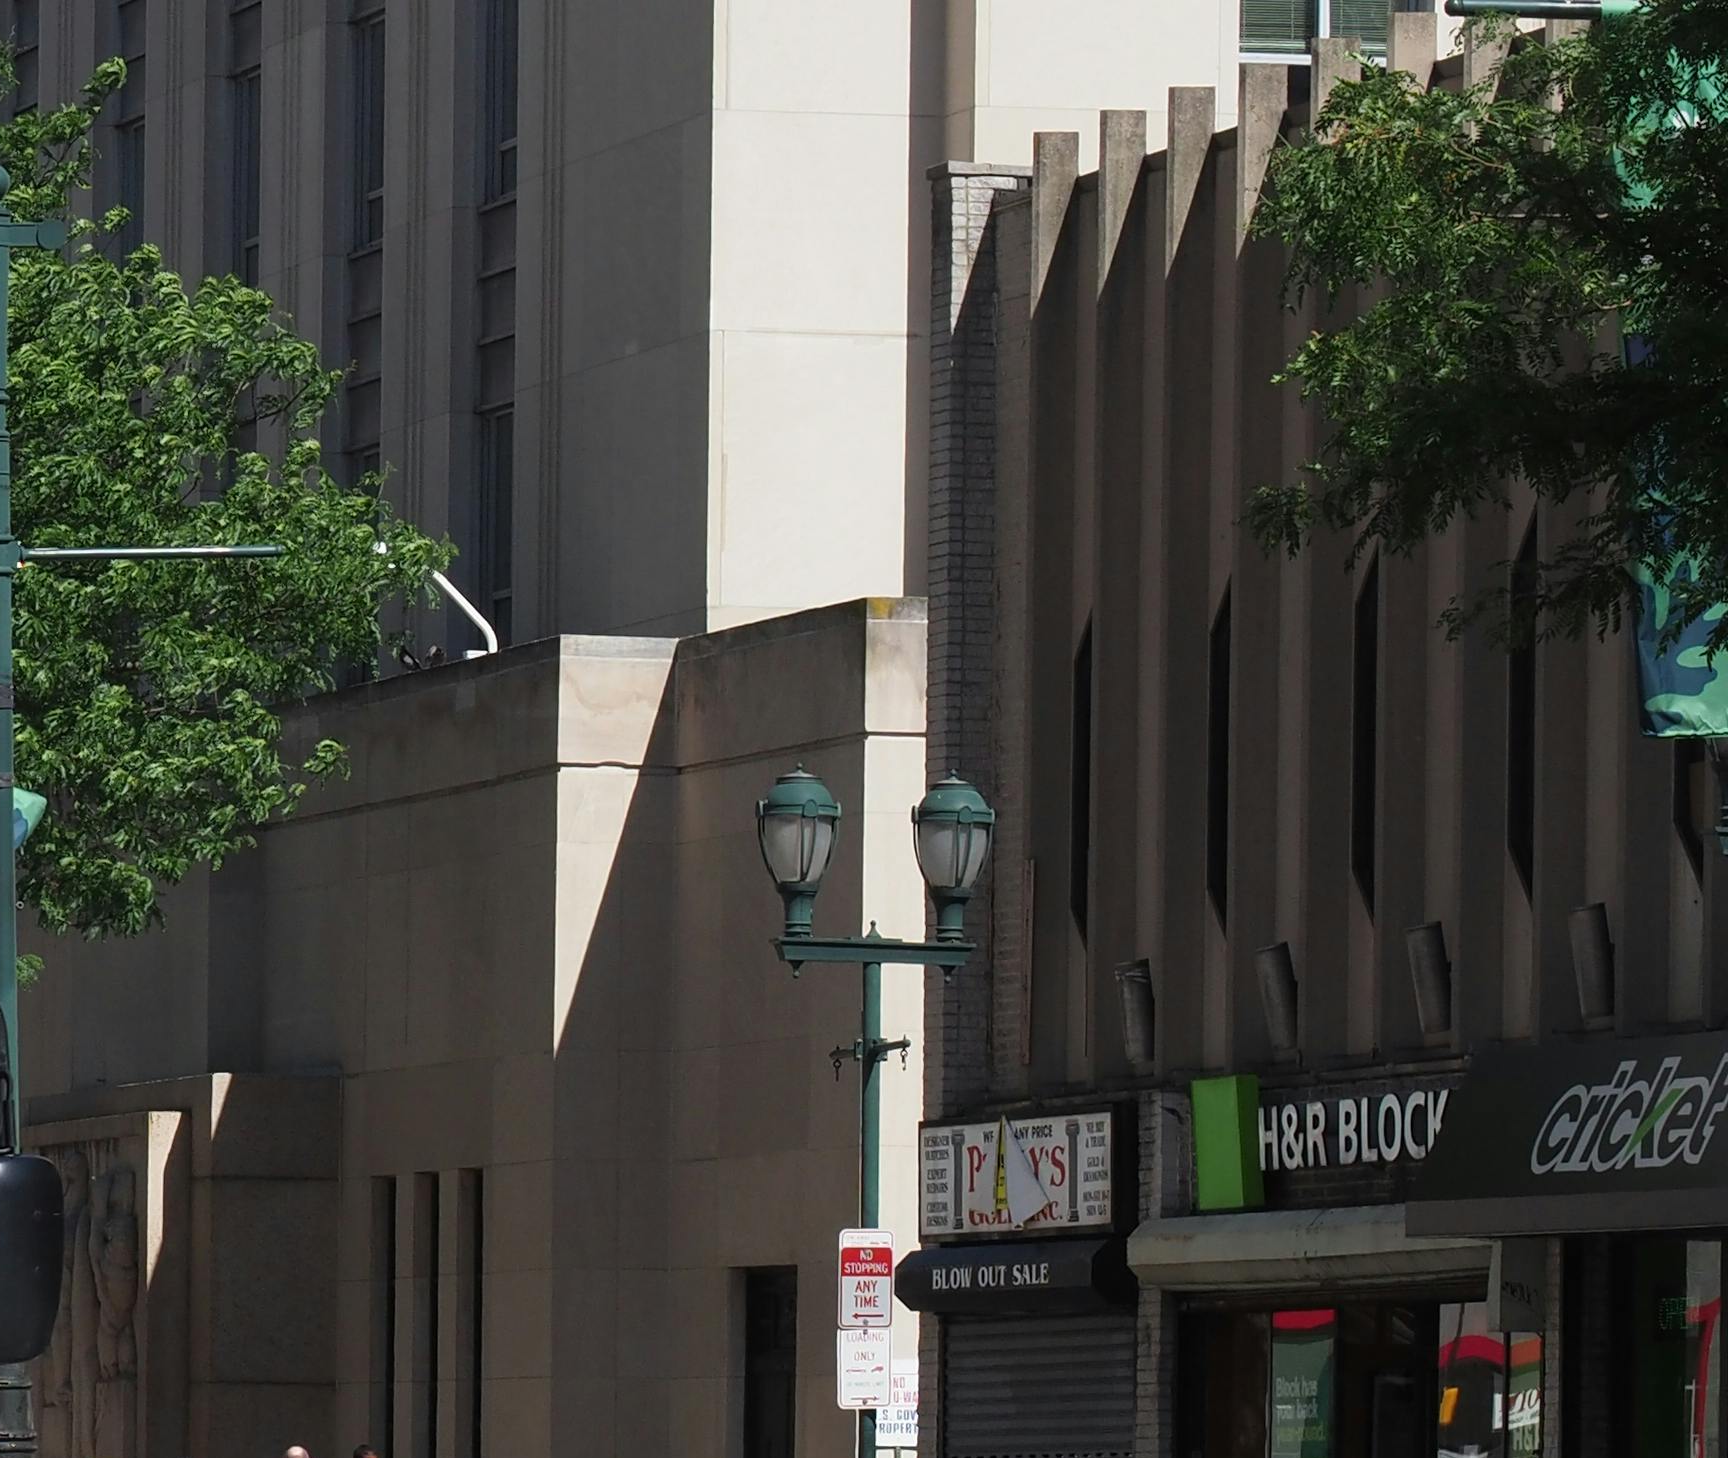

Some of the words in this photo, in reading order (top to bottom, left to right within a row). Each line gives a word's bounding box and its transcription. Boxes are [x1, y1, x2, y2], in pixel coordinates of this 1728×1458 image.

[1530, 1051, 1728, 1175] cricket
[1031, 1124, 1053, 1138] PRICE
[1257, 1101, 1328, 1172] H&R
[1338, 1088, 1449, 1164] BLOCK
[859, 1249, 874, 1261] NO
[844, 1262, 889, 1274] STOPPING
[932, 1266, 973, 1290] BLOW
[978, 1265, 1007, 1288] OUT
[1012, 1263, 1049, 1286] SALE
[855, 1280, 879, 1294] ANY
[853, 1295, 880, 1309] TIME
[846, 1330, 885, 1343] LOADING
[854, 1351, 876, 1362] ONLY
